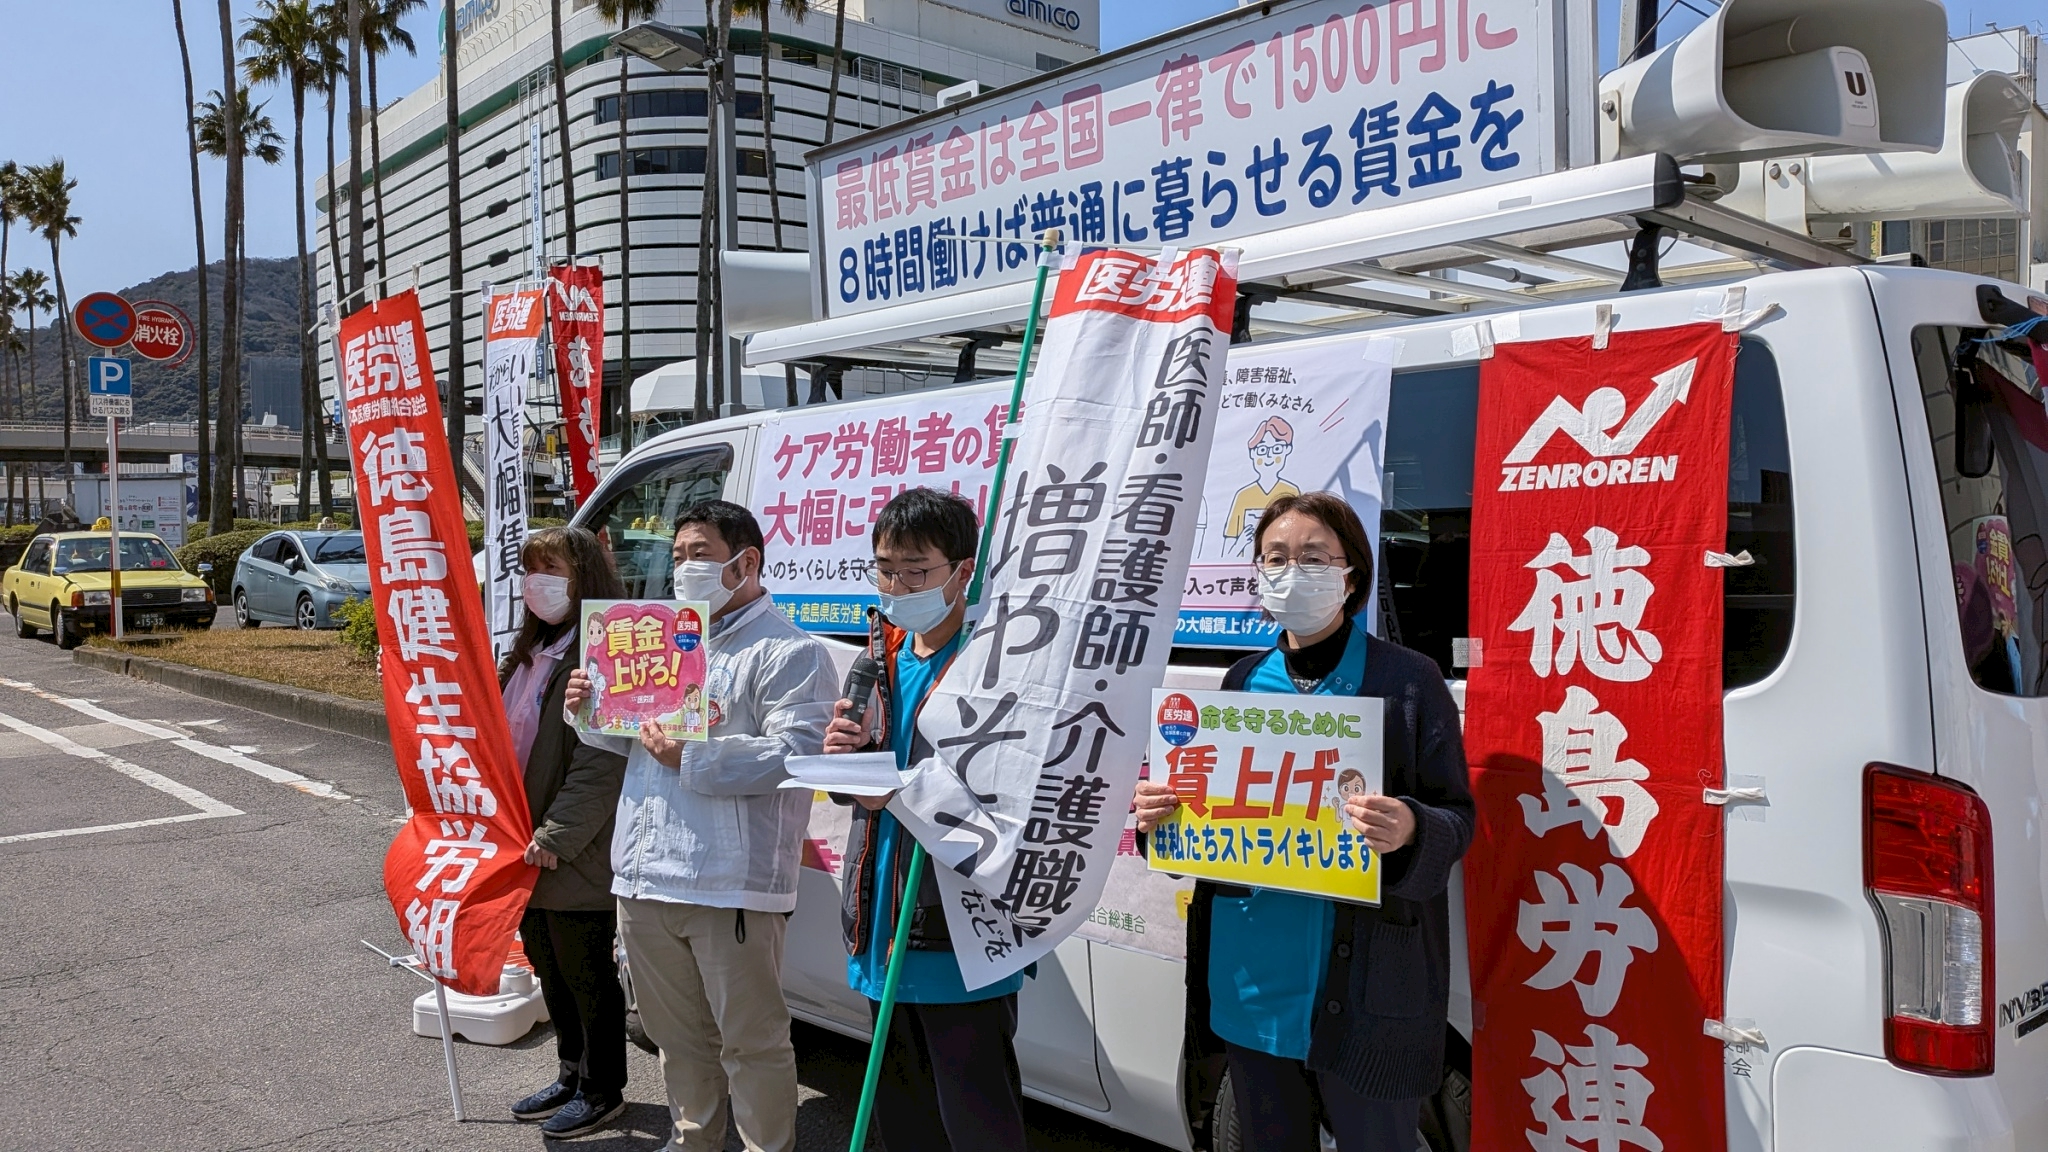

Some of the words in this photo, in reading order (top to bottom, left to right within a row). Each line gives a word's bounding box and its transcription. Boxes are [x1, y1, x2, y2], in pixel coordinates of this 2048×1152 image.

[1007, 0, 1080, 31] amico
[1844, 71, 1867, 97] U
[836, 0, 1517, 230] 最低賃金は全国一律で1500円に
[839, 79, 1525, 304] 8時間働けば普通に暮らせる賃金を
[1083, 250, 1220, 315] 医労連
[134, 324, 180, 346] 消火栓
[492, 296, 537, 334] 医労連
[100, 361, 124, 391] P
[345, 320, 422, 401] 医労連
[1497, 455, 1679, 493] ZENROREN
[605, 615, 666, 657] 賃金
[677, 620, 699, 631] 医労連
[609, 651, 681, 694] 上げろ!
[360, 427, 499, 981] 徳島健生協労組
[1163, 708, 1194, 722] 医労連
[1200, 704, 1362, 739] 命を守るために
[1165, 745, 1341, 822] 賃上げ
[1155, 823, 1371, 873] #私たちストライキします
[1507, 526, 1664, 1152] 徳島労連
